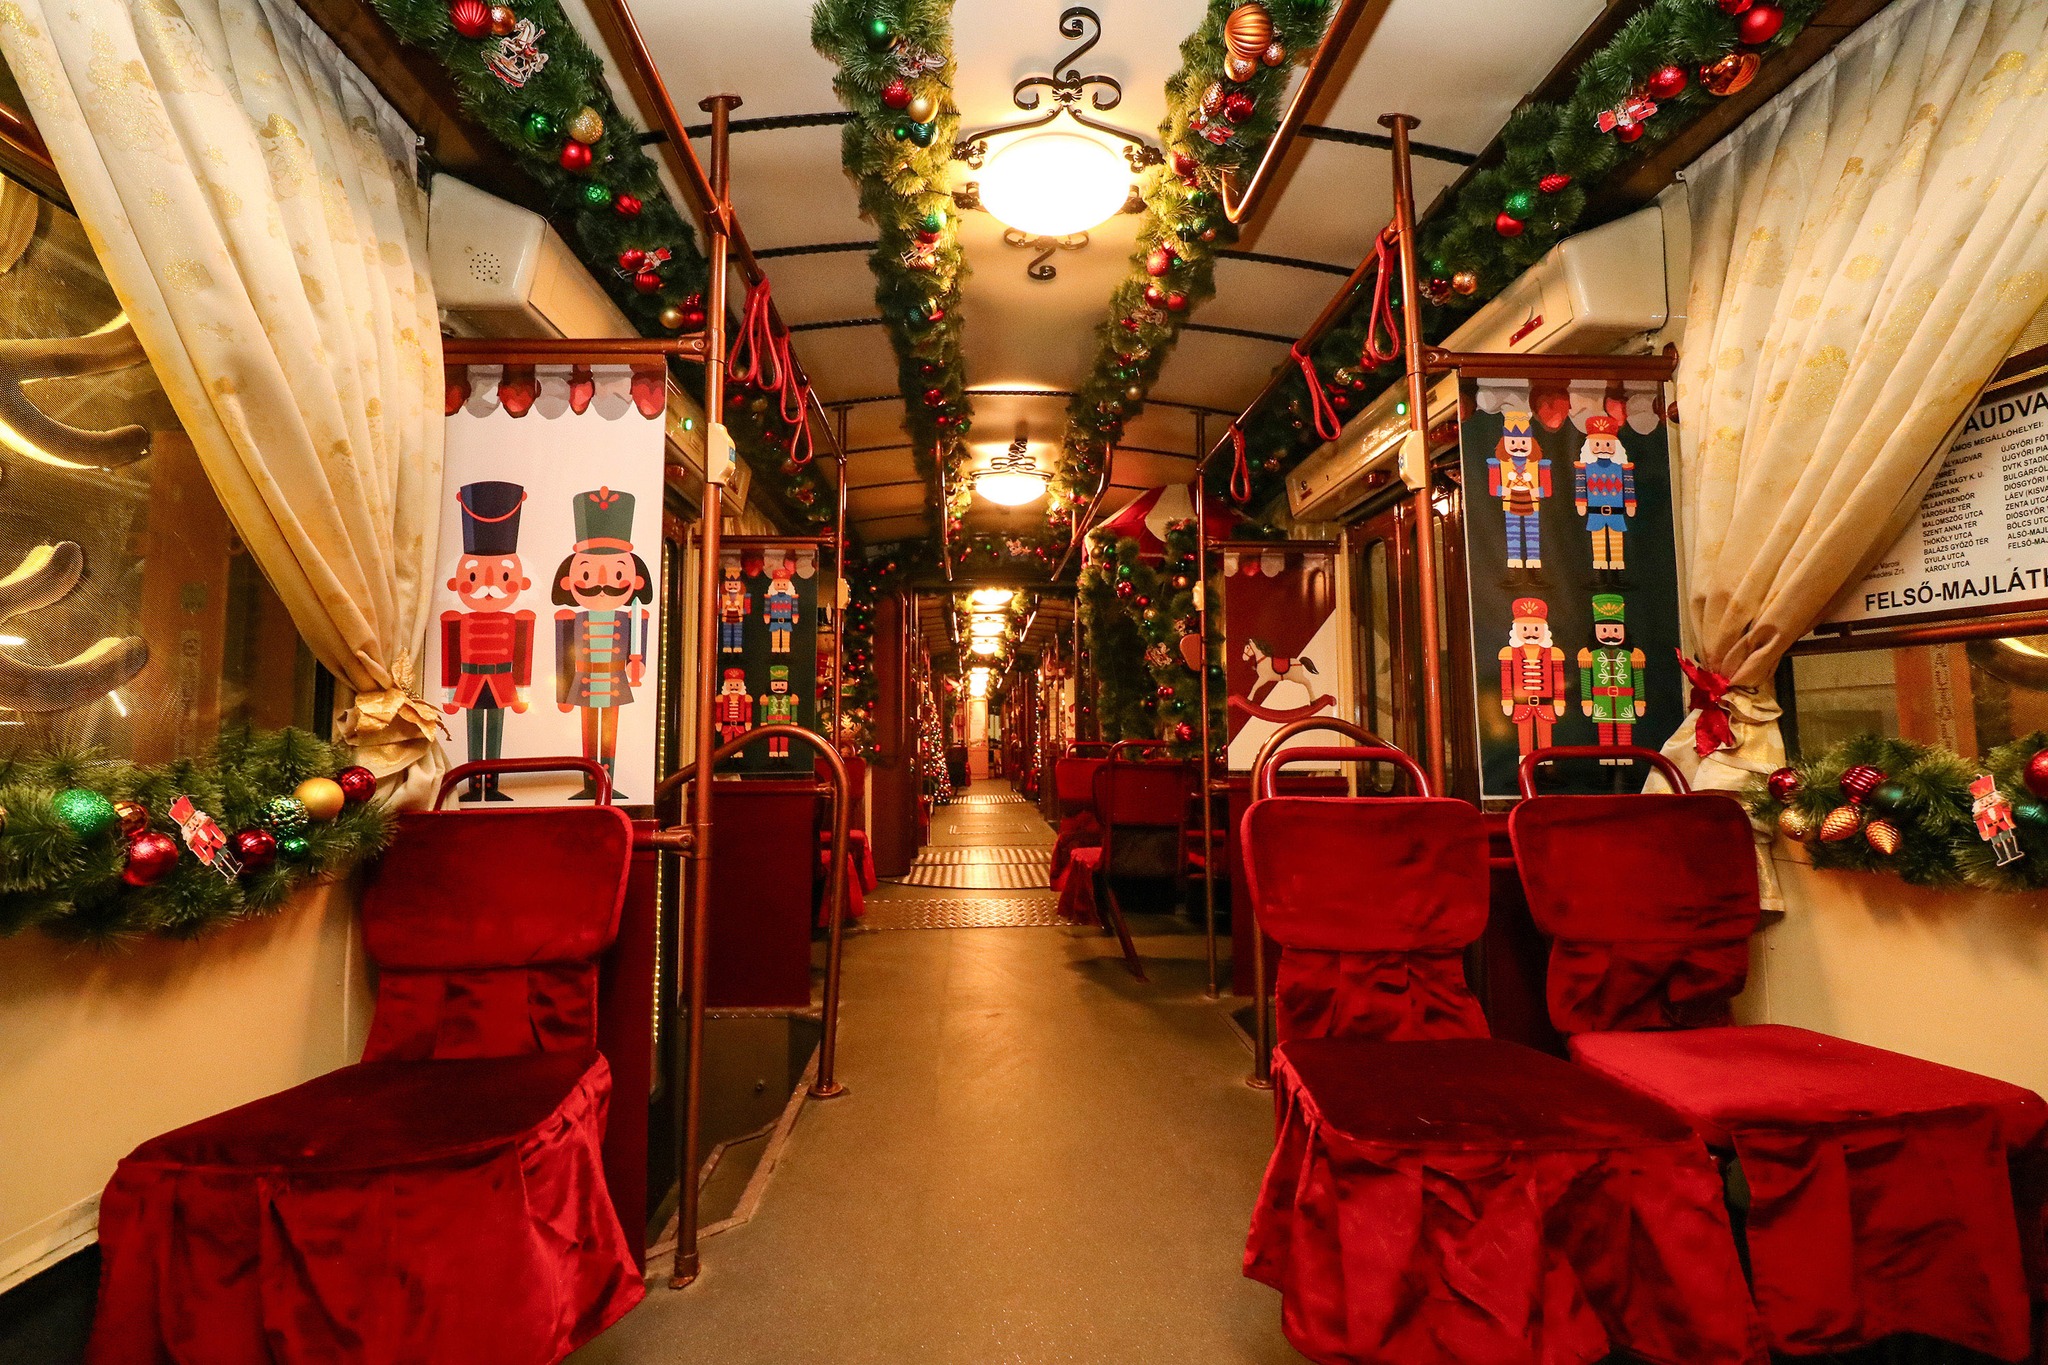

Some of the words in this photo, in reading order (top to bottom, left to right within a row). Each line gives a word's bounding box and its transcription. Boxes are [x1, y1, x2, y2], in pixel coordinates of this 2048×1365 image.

[2002, 461, 2022, 472] DVTK
[1949, 475, 1968, 486] NAGY
[2005, 500, 2029, 511] ZENTA
[1964, 509, 1984, 520] UTCA
[1922, 527, 1943, 538] SZENT
[1944, 523, 1963, 533] ANNA
[1954, 531, 1973, 541] UTCA
[1924, 555, 1946, 565] GYULA
[1947, 551, 1966, 561] UTCA
[1951, 560, 1971, 569] UTCA
